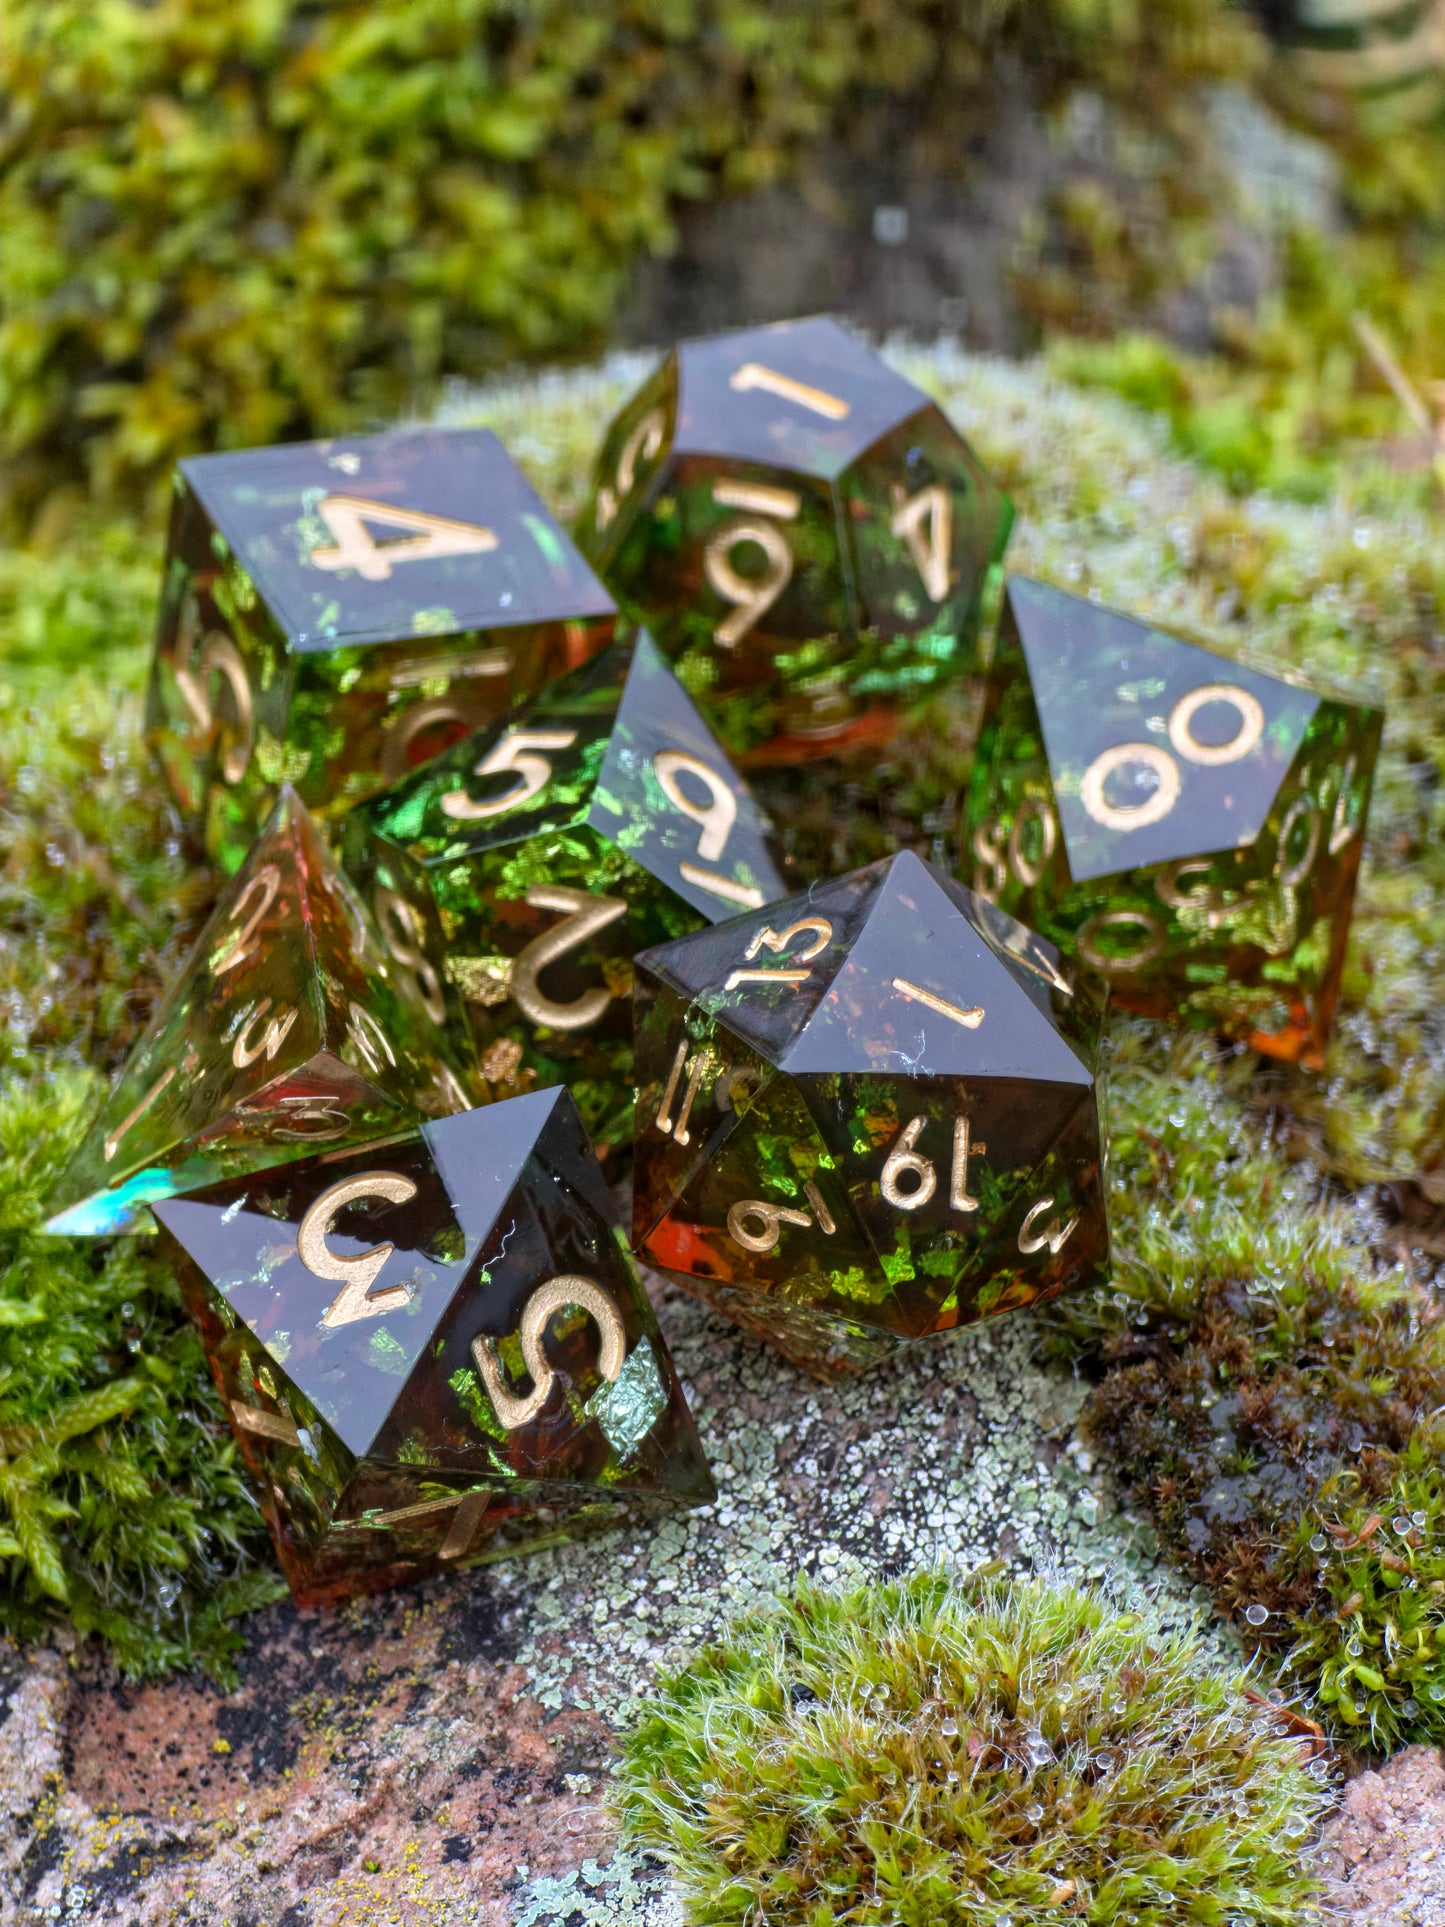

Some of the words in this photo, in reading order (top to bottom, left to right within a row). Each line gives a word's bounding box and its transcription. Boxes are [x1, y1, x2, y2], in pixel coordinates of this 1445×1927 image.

[729, 363, 850, 419] 1
[311, 494, 499, 581] 4
[890, 483, 952, 602] 4
[440, 728, 577, 820] 5
[654, 750, 738, 862] 9
[1080, 684, 1264, 831] 00
[211, 863, 280, 976] 2
[512, 883, 628, 1028] 2
[724, 916, 832, 991] 13
[233, 997, 299, 1068] 3
[891, 976, 985, 1030] 1
[656, 1038, 690, 1146] 11
[880, 1113, 979, 1211] 19
[297, 1169, 417, 1328] 3
[1018, 1194, 1080, 1254] 3
[470, 1273, 625, 1429] 5
